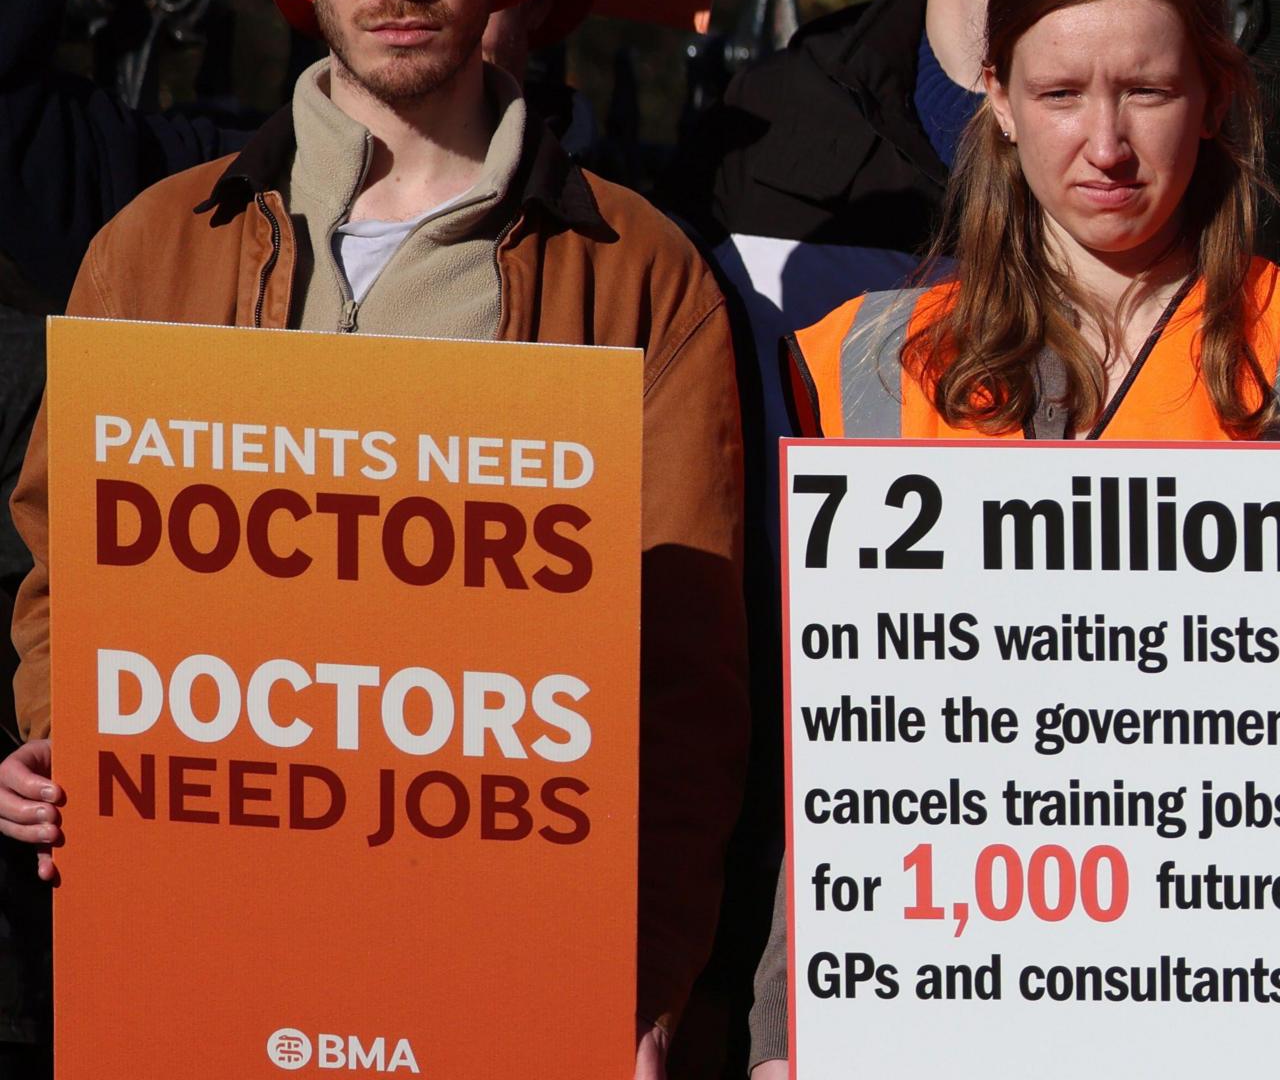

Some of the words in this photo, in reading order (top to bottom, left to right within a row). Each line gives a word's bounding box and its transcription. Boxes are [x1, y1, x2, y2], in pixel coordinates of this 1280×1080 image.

[95, 415, 398, 481] PATIENTS
[419, 435, 594, 488] NEED
[96, 479, 593, 593] DOCTORS
[792, 473, 945, 571] 7.2
[801, 621, 859, 660] on
[877, 613, 980, 661] NHS
[995, 614, 1168, 673] waiting
[97, 648, 592, 763] DOCTORS
[801, 695, 926, 743] while
[942, 697, 1018, 743] the
[98, 751, 347, 830] NEED
[367, 768, 591, 848] JOBS
[804, 779, 987, 825] cancels
[1003, 779, 1187, 838] training
[811, 863, 881, 911] for
[902, 843, 1129, 938] 1,000
[807, 952, 899, 1000] GPs
[915, 954, 1001, 1001] and
[318, 1034, 420, 1074] BMA
